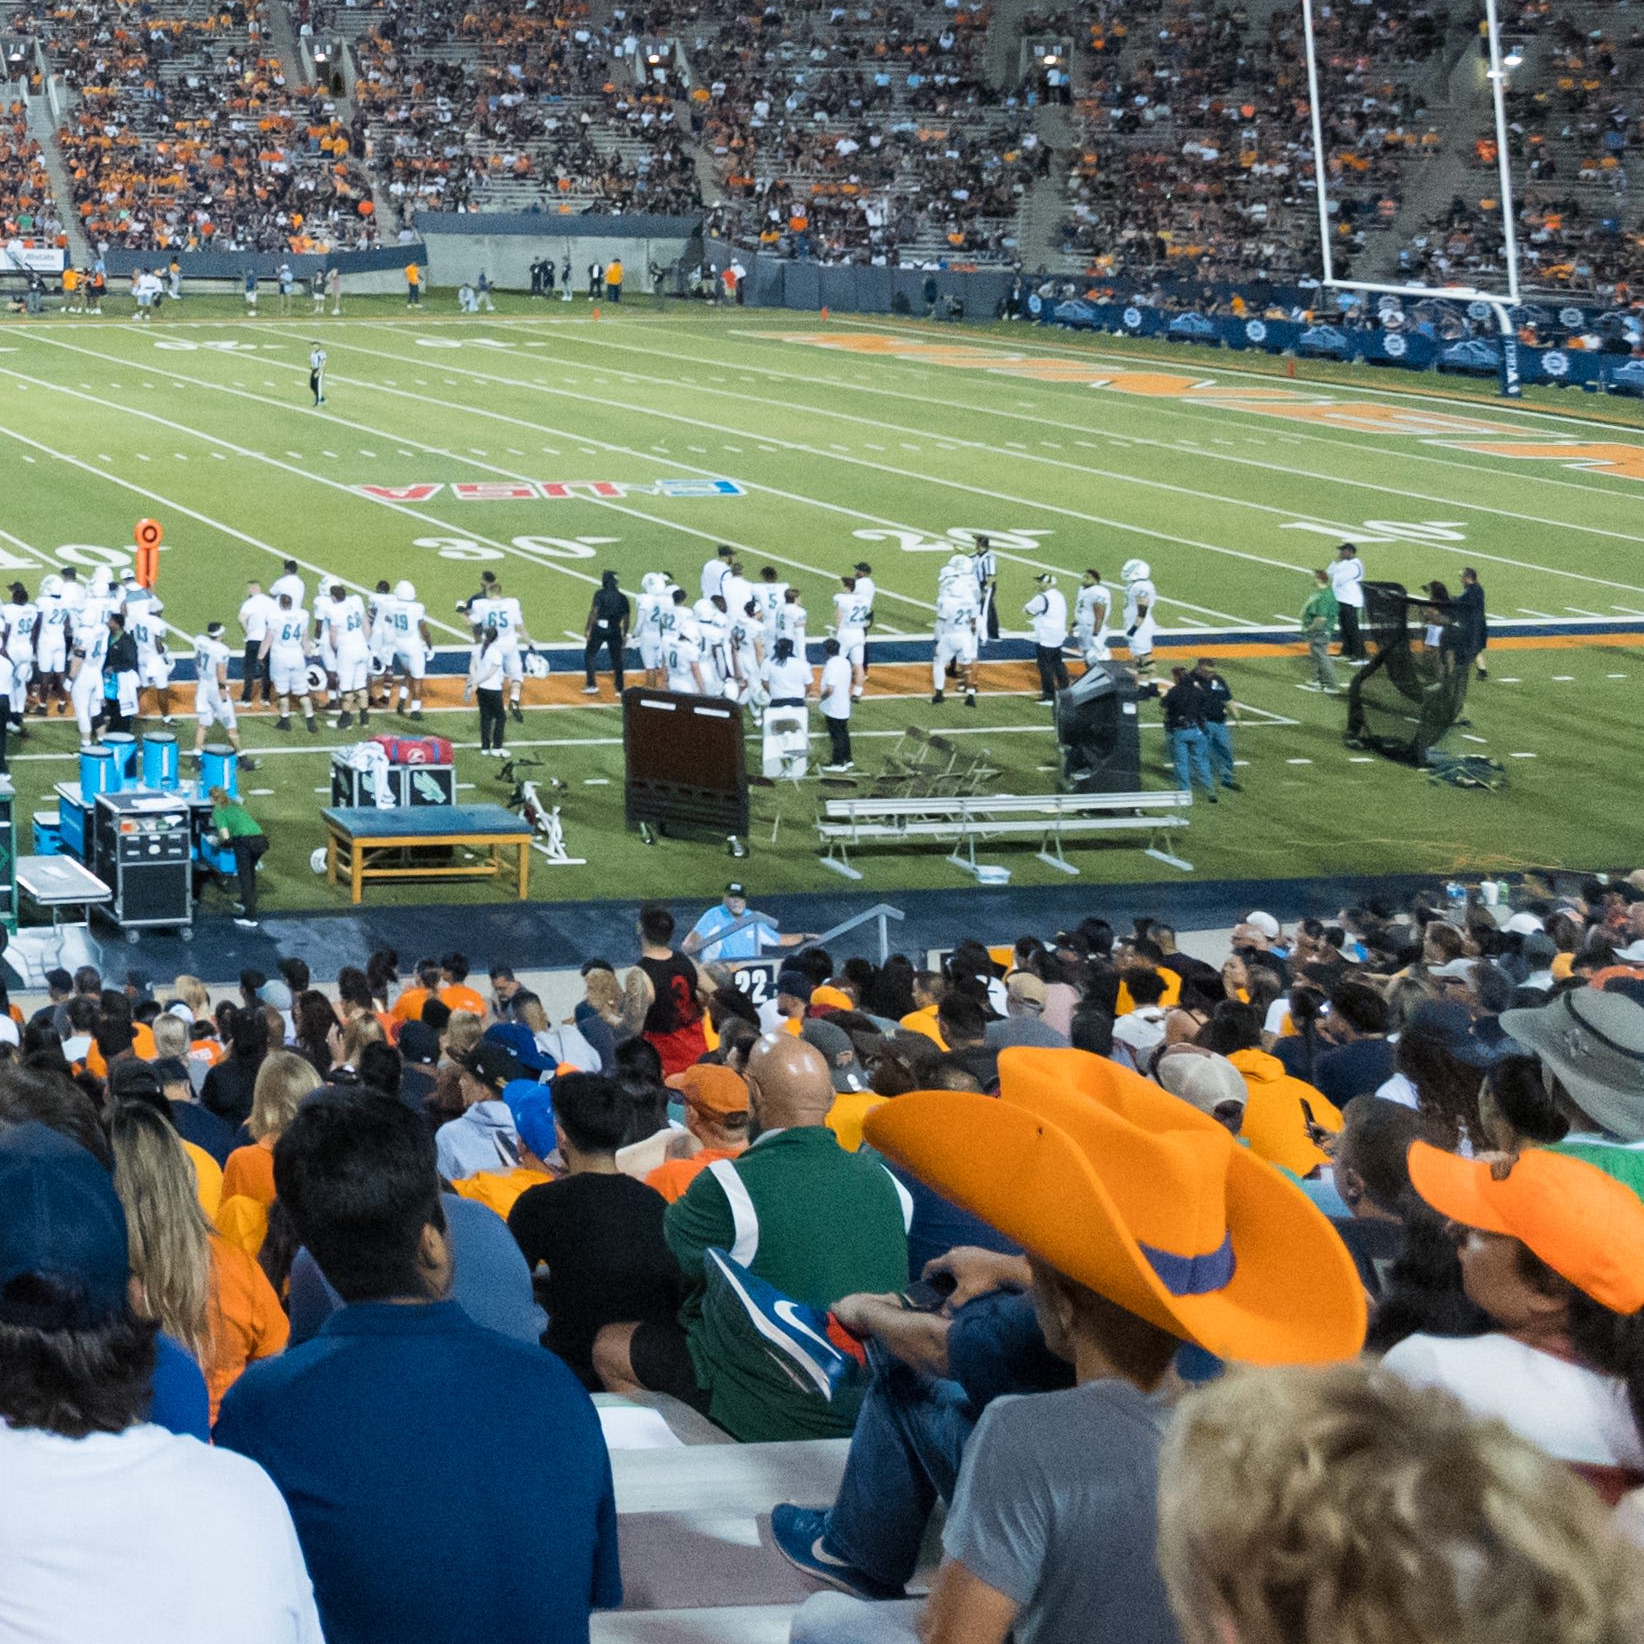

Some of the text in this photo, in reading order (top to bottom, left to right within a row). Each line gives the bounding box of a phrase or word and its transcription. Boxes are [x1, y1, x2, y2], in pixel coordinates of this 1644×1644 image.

[487, 610, 509, 629] 65
[281, 623, 301, 642] 64
[734, 968, 768, 1004] 22
